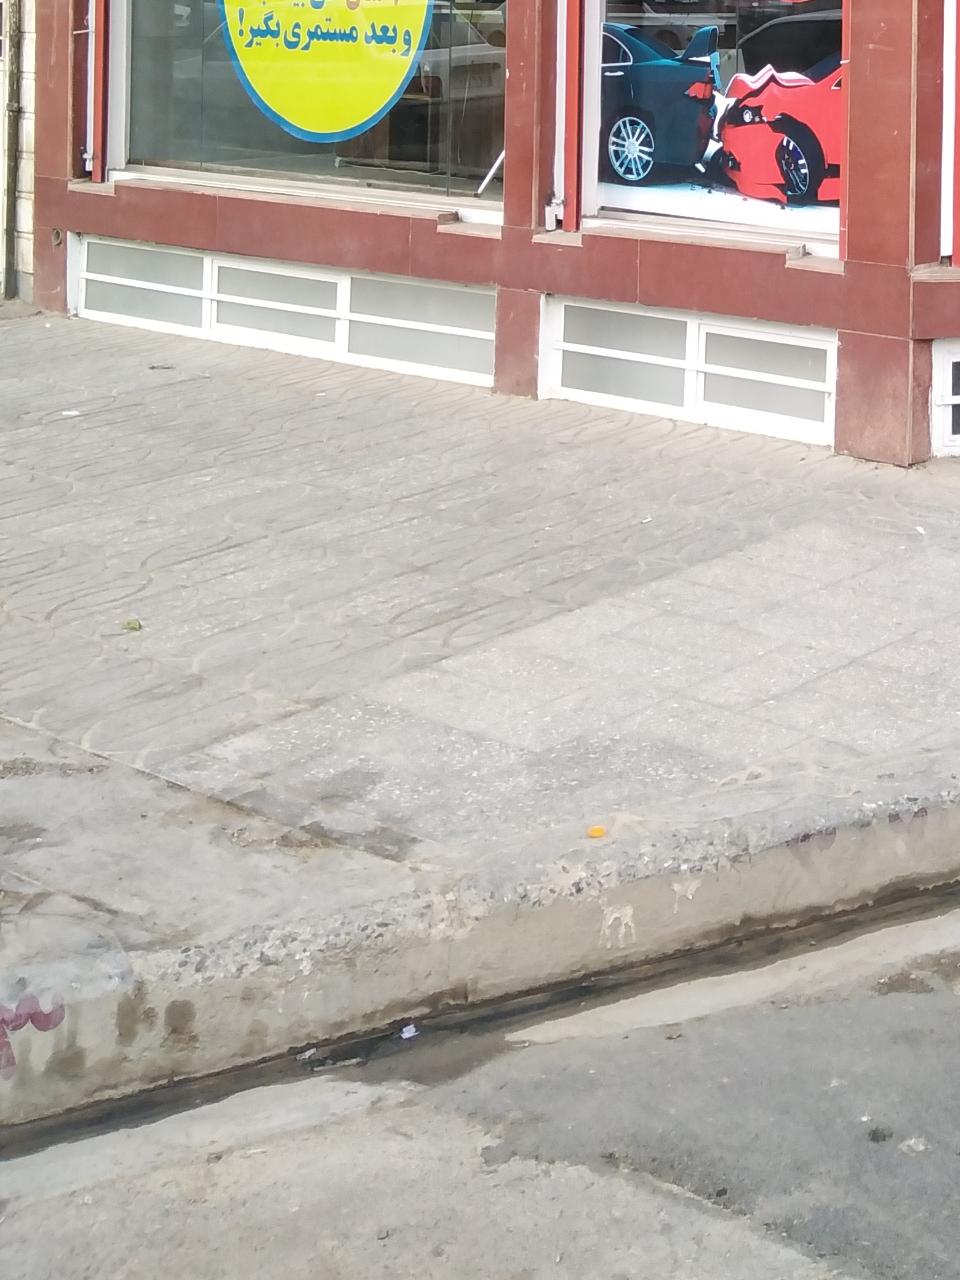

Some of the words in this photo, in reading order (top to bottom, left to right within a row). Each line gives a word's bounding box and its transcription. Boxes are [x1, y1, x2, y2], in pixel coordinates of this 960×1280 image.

[283, 16, 359, 51] مستمری
[364, 21, 398, 54] بعد
[400, 28, 413, 57] و
